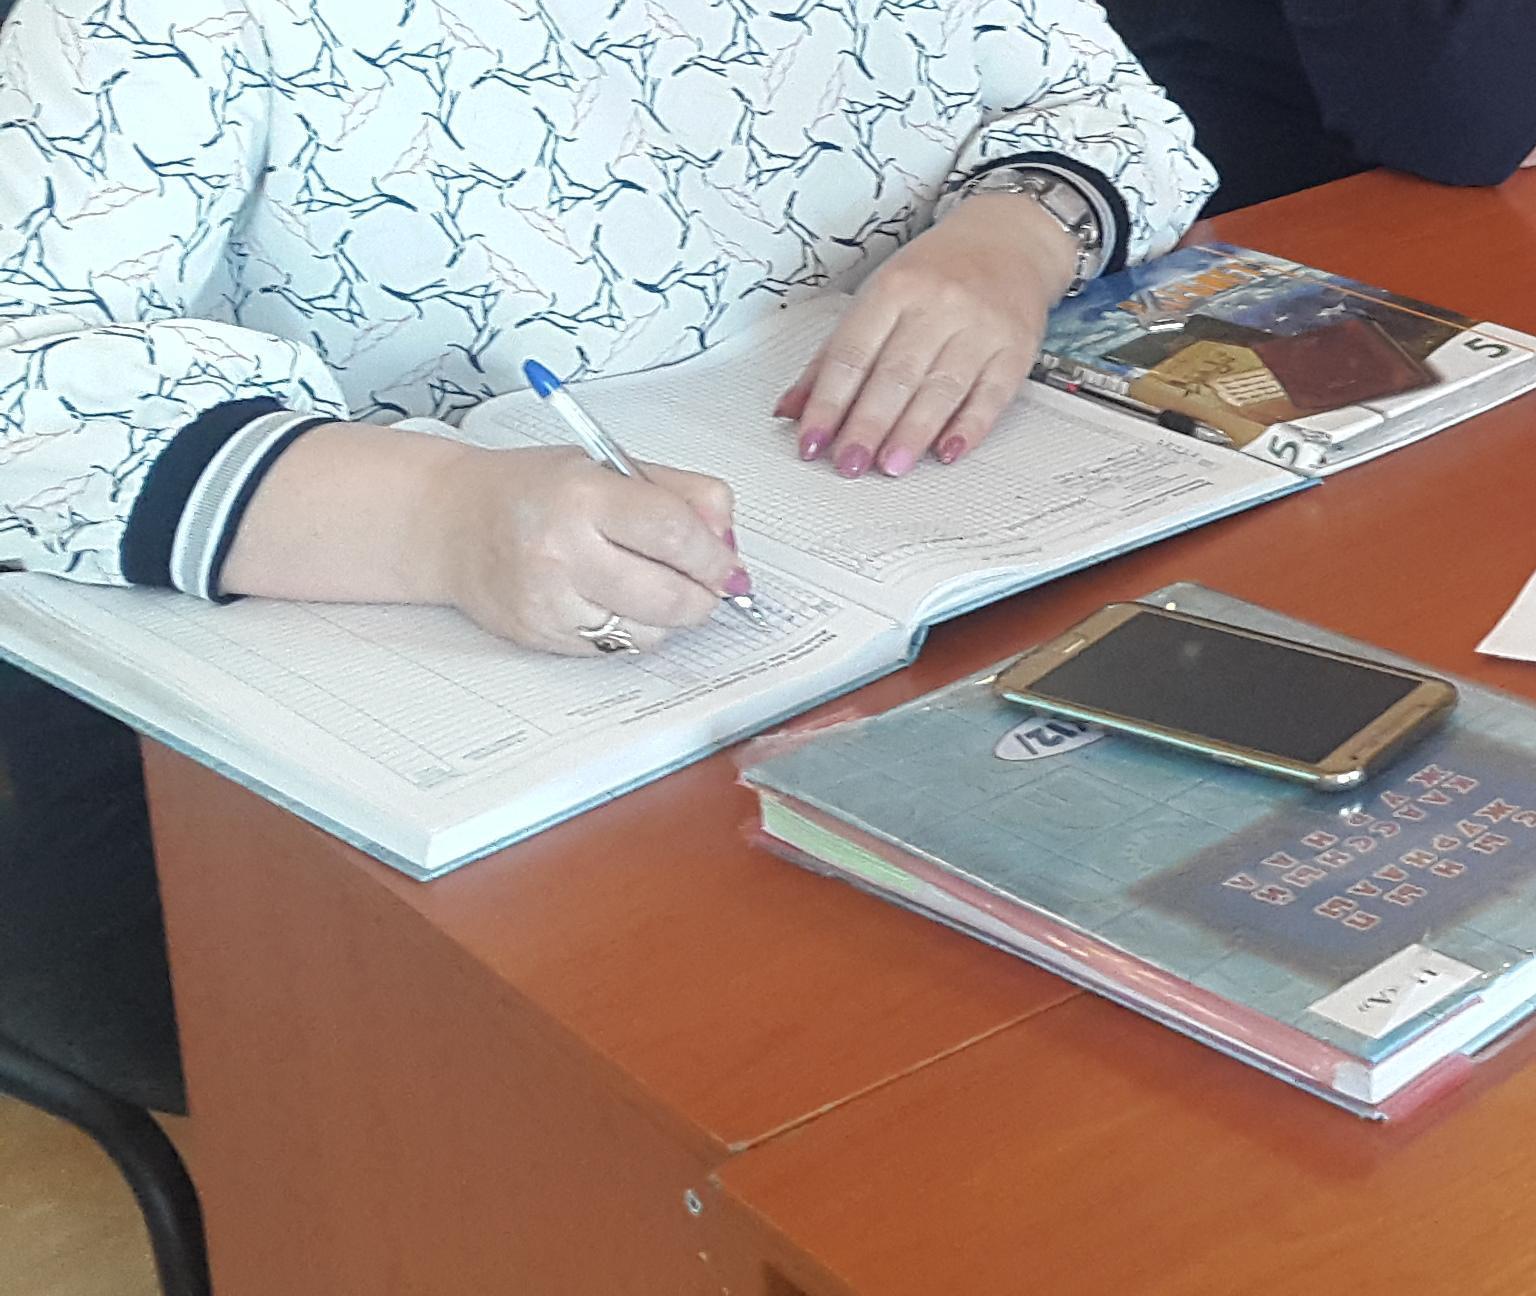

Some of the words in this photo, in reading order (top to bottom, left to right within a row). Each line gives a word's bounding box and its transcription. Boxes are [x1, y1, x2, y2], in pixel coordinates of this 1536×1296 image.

[1463, 337, 1510, 360] 5
[1266, 434, 1301, 465] 5
[1222, 764, 1448, 890] ЖУРНАЛ
[1250, 773, 1478, 906] КЛАССНЫЙ
[1313, 798, 1517, 919] ЖУРНАЛЫ
